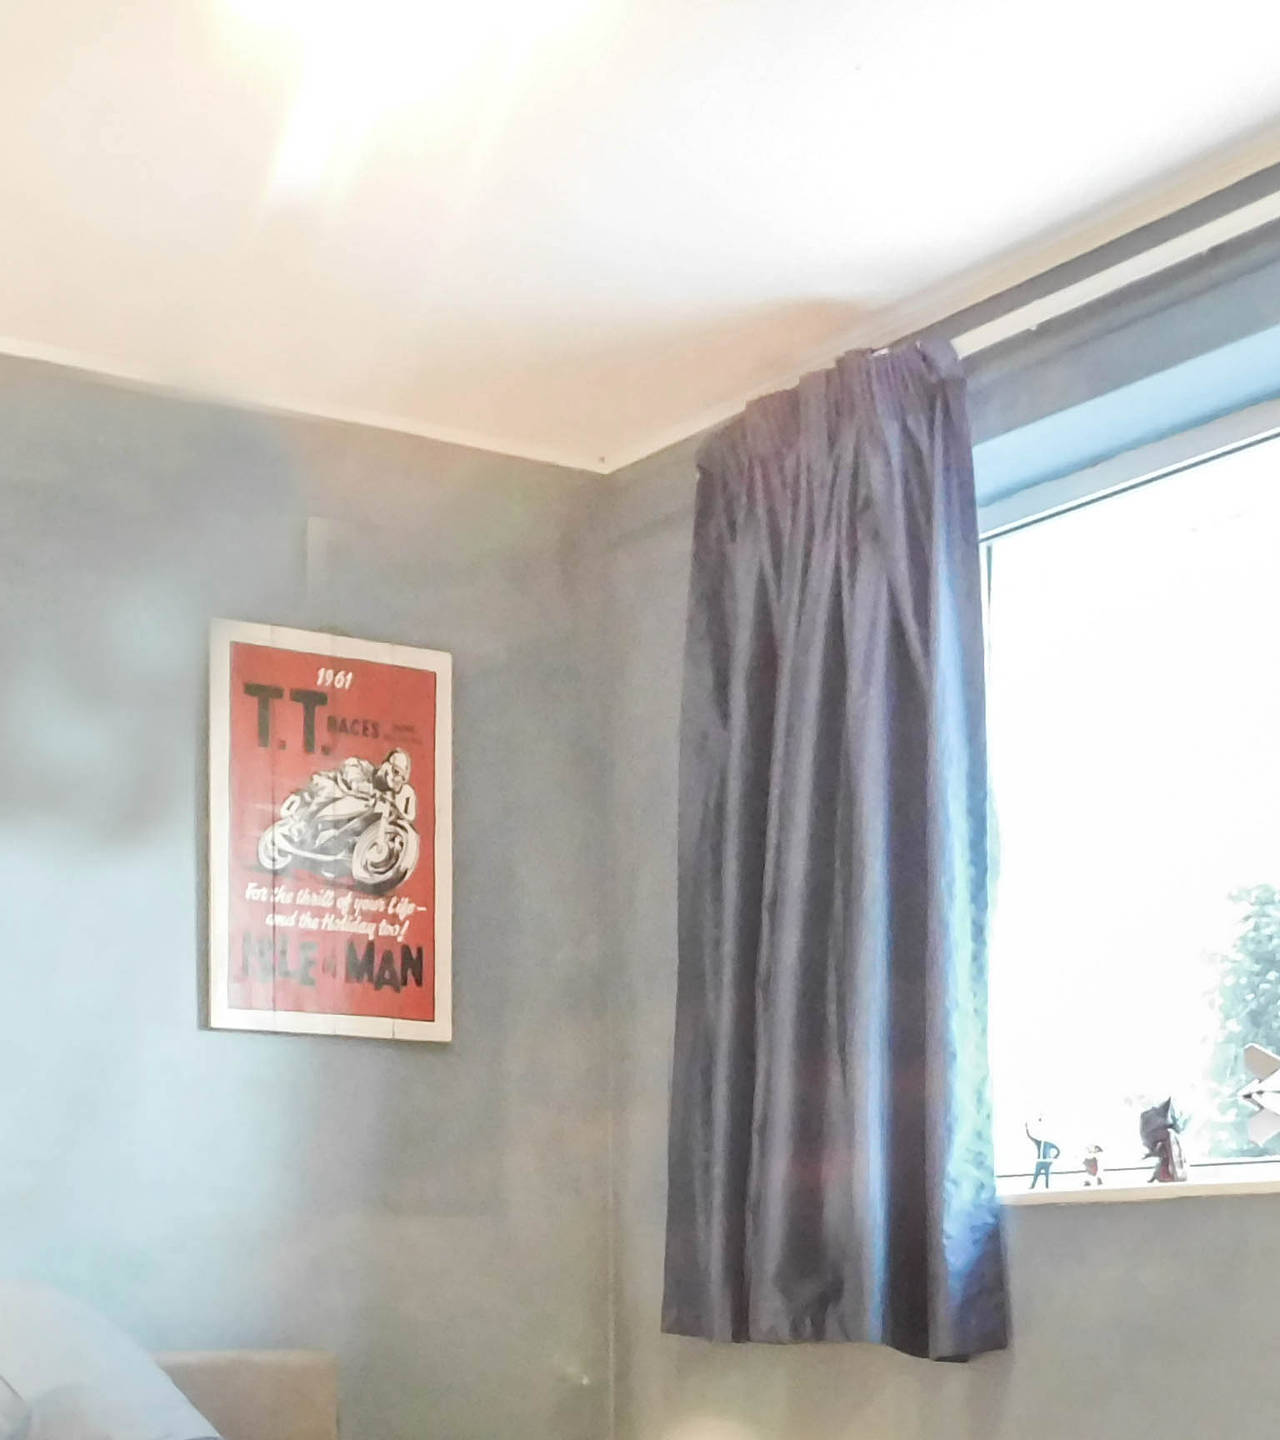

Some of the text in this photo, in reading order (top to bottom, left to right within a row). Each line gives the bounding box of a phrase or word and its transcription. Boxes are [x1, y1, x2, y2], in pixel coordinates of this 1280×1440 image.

[316, 667, 354, 690] 1961
[326, 715, 380, 740] RACES
[244, 881, 268, 902] For
[295, 887, 336, 908] thrill
[336, 891, 353, 916] of
[265, 910, 298, 928] and
[344, 938, 424, 994] MAN
